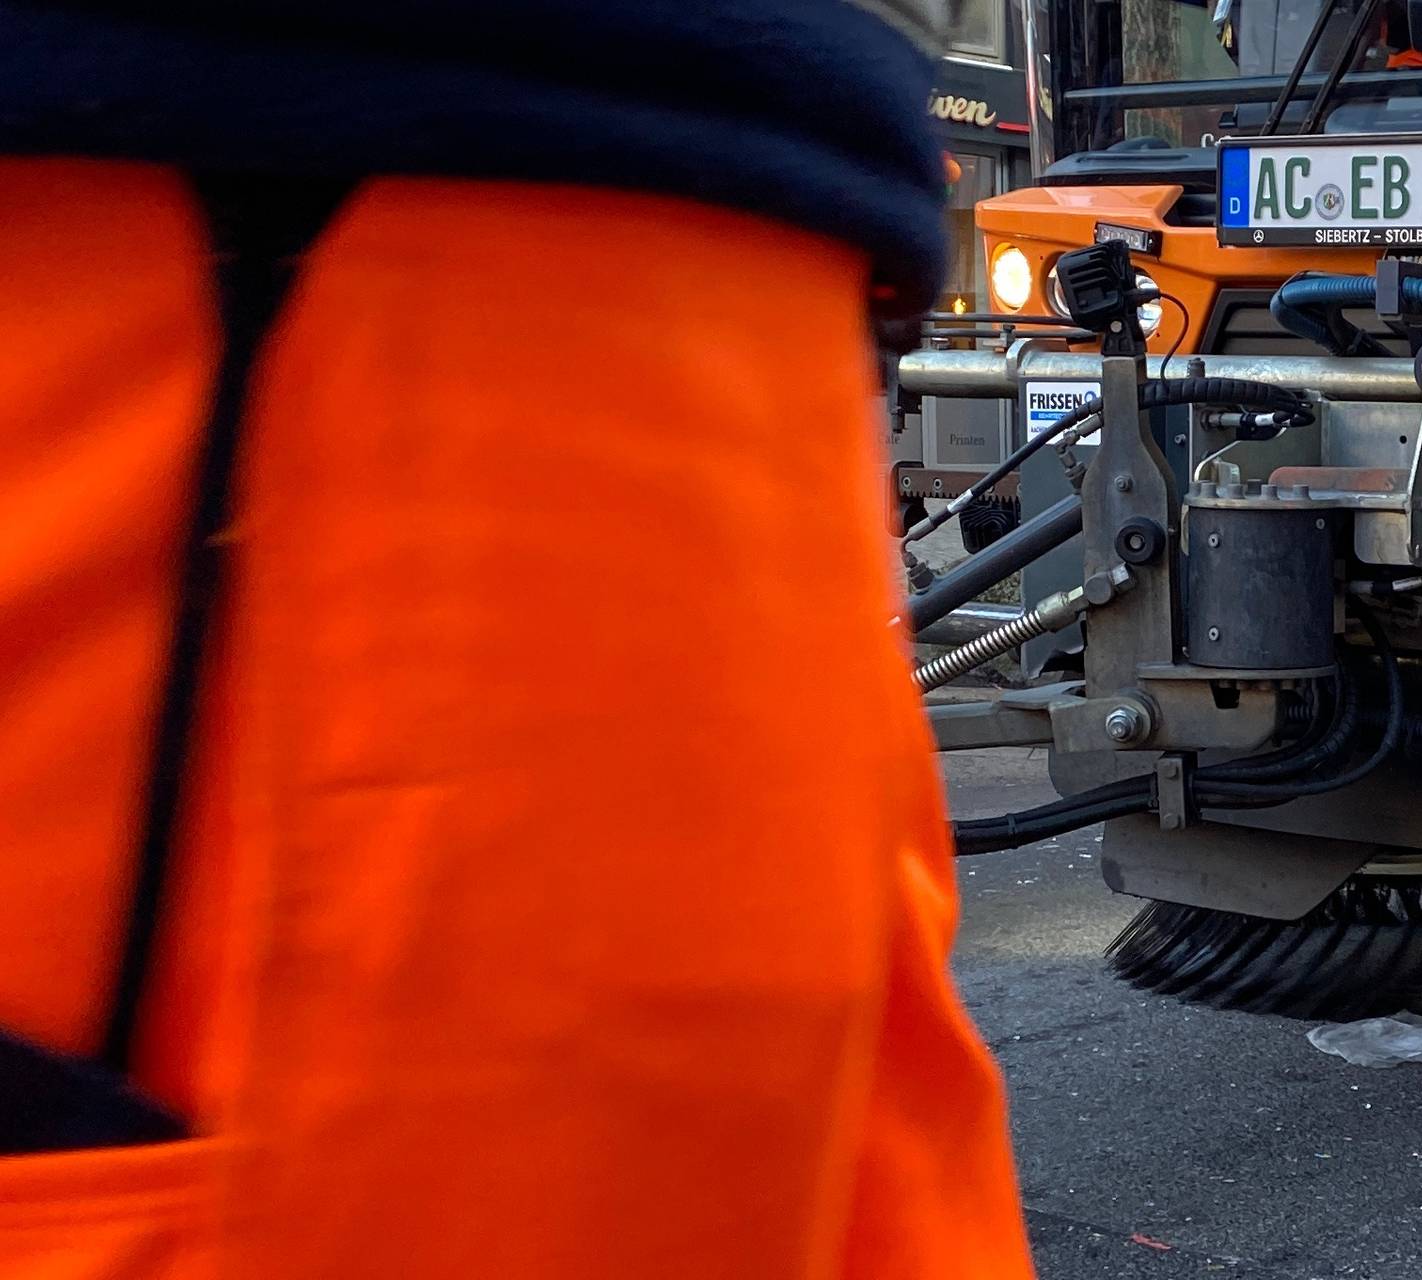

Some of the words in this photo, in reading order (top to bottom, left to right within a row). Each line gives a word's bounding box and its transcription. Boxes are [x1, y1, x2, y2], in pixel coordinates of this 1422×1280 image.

[1253, 156, 1312, 220] AC
[1351, 155, 1411, 219] EB
[1229, 197, 1241, 214] D
[1315, 229, 1370, 243] SIEBERTZ
[1030, 393, 1083, 410] FRISSEN
[949, 433, 986, 446] Printen
